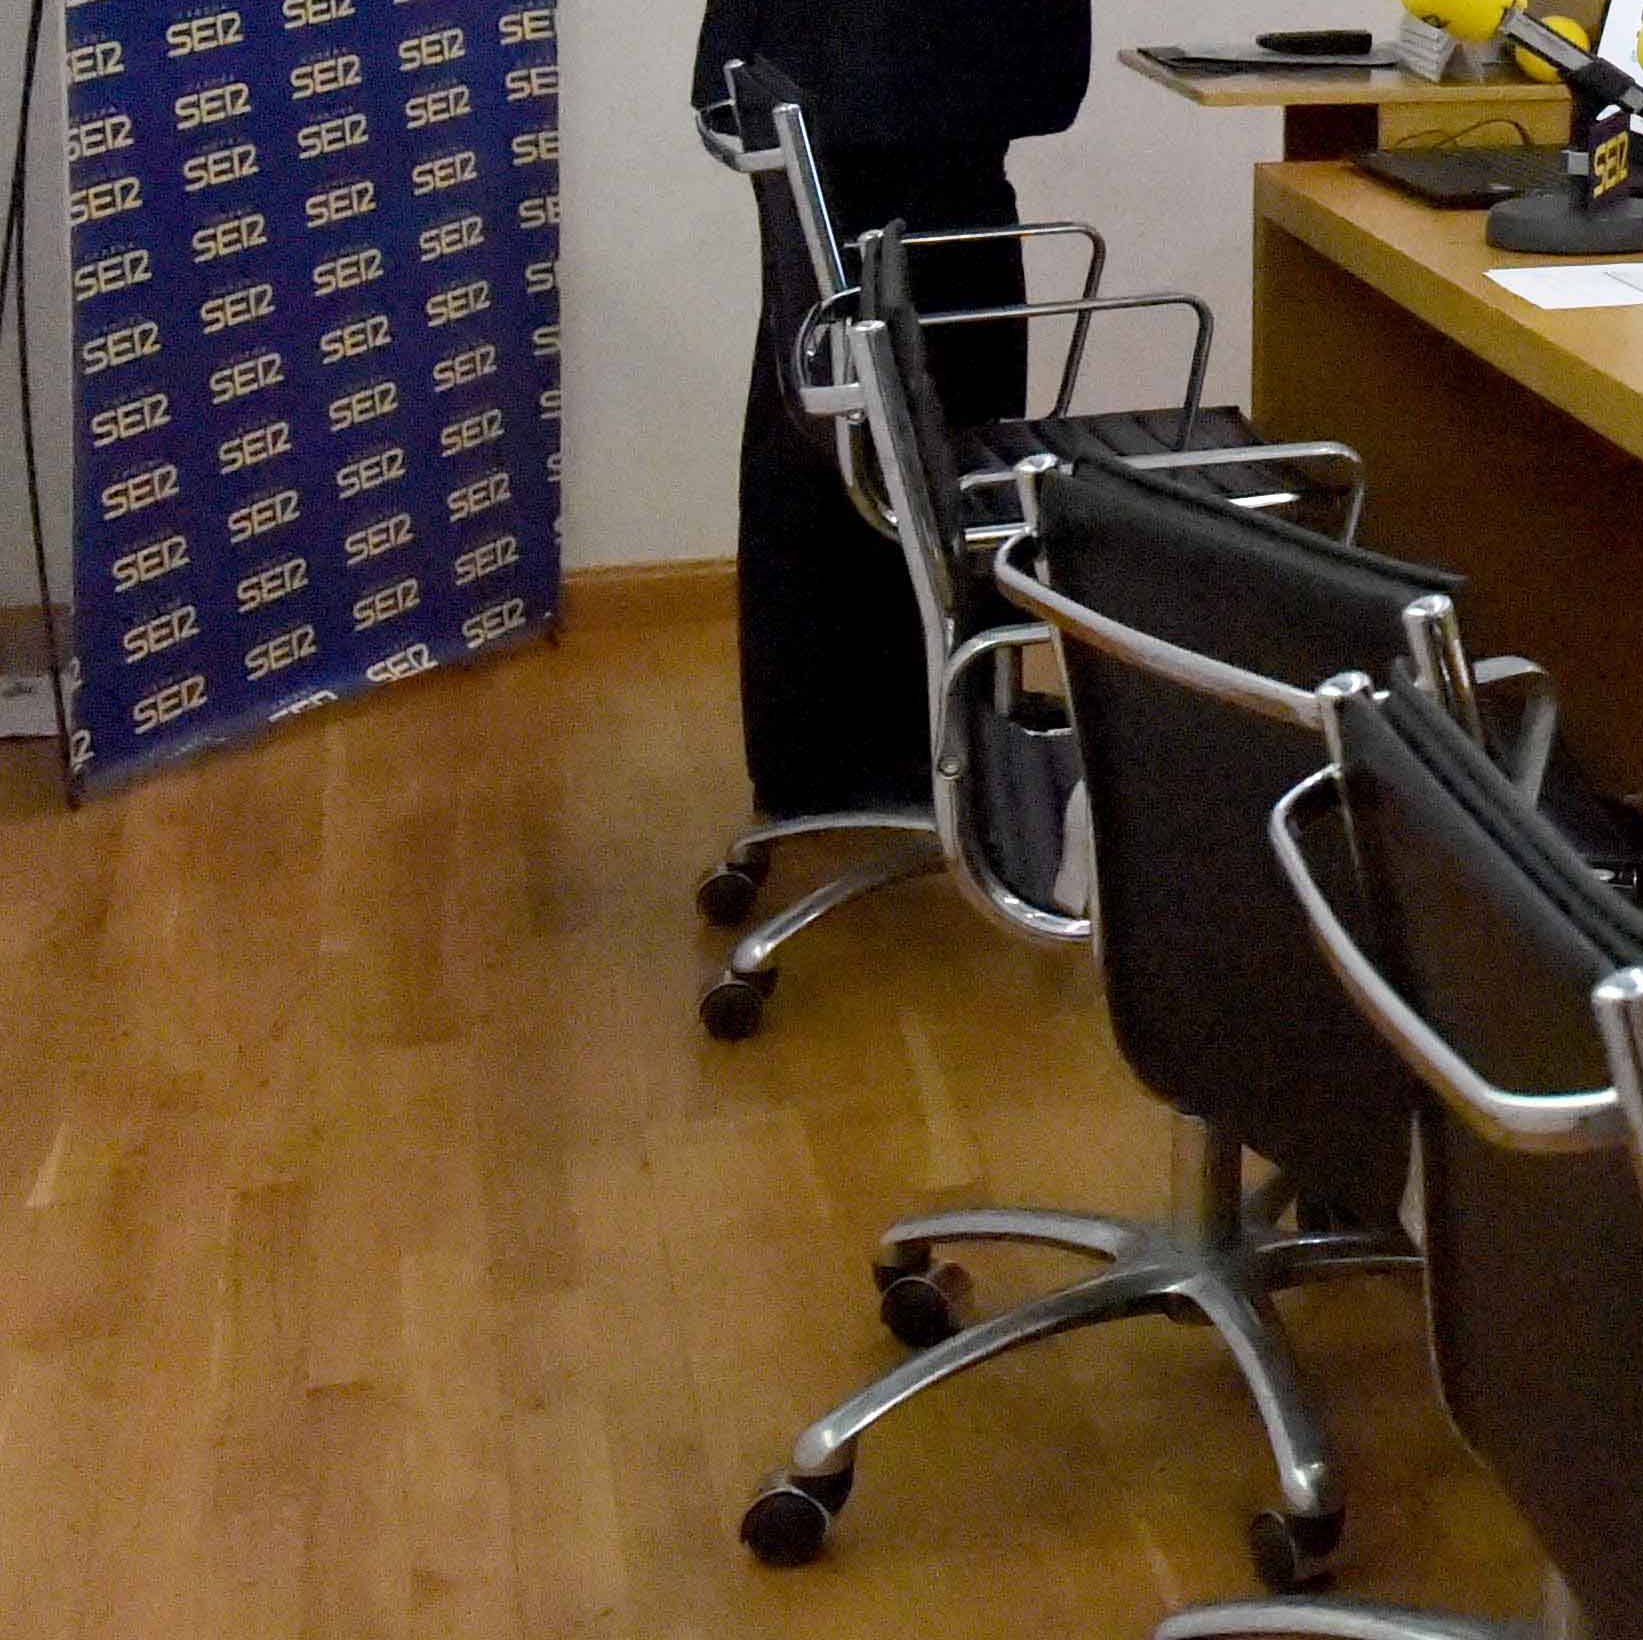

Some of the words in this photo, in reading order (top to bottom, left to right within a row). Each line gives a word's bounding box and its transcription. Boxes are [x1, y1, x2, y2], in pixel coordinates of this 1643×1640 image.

[166, 11, 243, 57] SER
[398, 28, 466, 71] SER
[499, 11, 557, 45] SE
[290, 54, 362, 99] SER
[505, 66, 559, 102] SE
[175, 83, 251, 130] SER
[405, 85, 471, 129] SER
[297, 113, 369, 159] SER
[512, 130, 559, 165] SE
[183, 144, 259, 191] SER
[412, 151, 478, 195] SER
[305, 180, 376, 228] SER
[192, 214, 267, 263] SER
[419, 215, 484, 261] SER
[74, 249, 153, 302] SER
[313, 248, 383, 296] SER
[200, 284, 275, 334] SER
[426, 280, 491, 327] SER
[82, 321, 161, 374] SER
[320, 315, 391, 364] SER
[210, 353, 284, 404] SER
[433, 344, 497, 392] SER
[91, 393, 171, 447] SER
[329, 382, 398, 432] SER
[218, 421, 292, 474] SER
[441, 409, 504, 457] SER
[101, 464, 179, 520] SER
[336, 447, 405, 499] SER
[447, 472, 511, 522] SER
[228, 490, 300, 543] SER
[344, 513, 413, 566] SER
[112, 536, 190, 592] SER
[237, 558, 308, 612] SER
[454, 535, 519, 586] SER
[353, 578, 420, 630] SER
[462, 598, 525, 650] SER
[123, 605, 200, 663] SER
[245, 625, 316, 680] SER
[133, 675, 207, 734] SER
